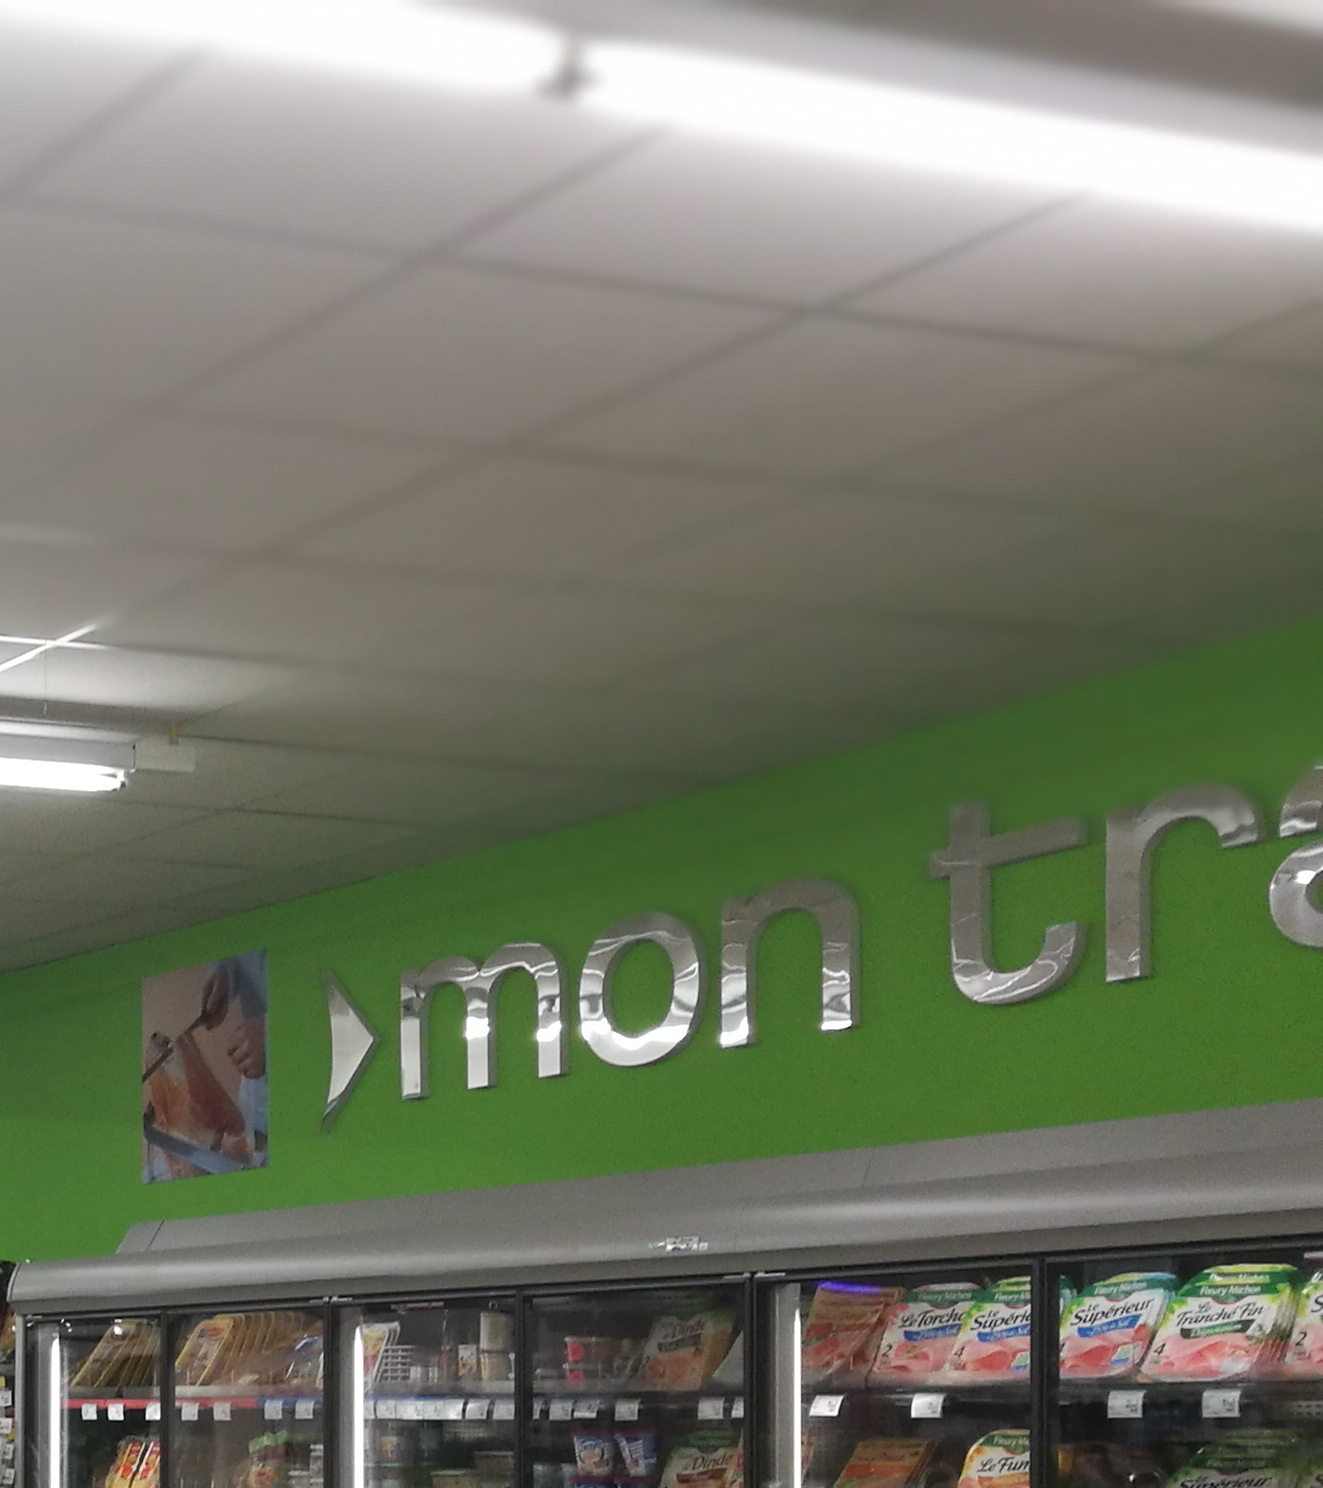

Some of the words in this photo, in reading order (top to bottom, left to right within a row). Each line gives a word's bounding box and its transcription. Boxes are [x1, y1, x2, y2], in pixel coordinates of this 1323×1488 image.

[400, 877, 862, 1102] mon
[1200, 1286, 1226, 1297] Fleury
[1227, 1284, 1261, 1295] Michon
[1070, 1299, 1154, 1327] Supérieur
[1176, 1306, 1238, 1327] Tranché
[691, 1451, 734, 1470] Dinde
[977, 1456, 997, 1474] Le
[997, 1456, 1030, 1474] Fum
